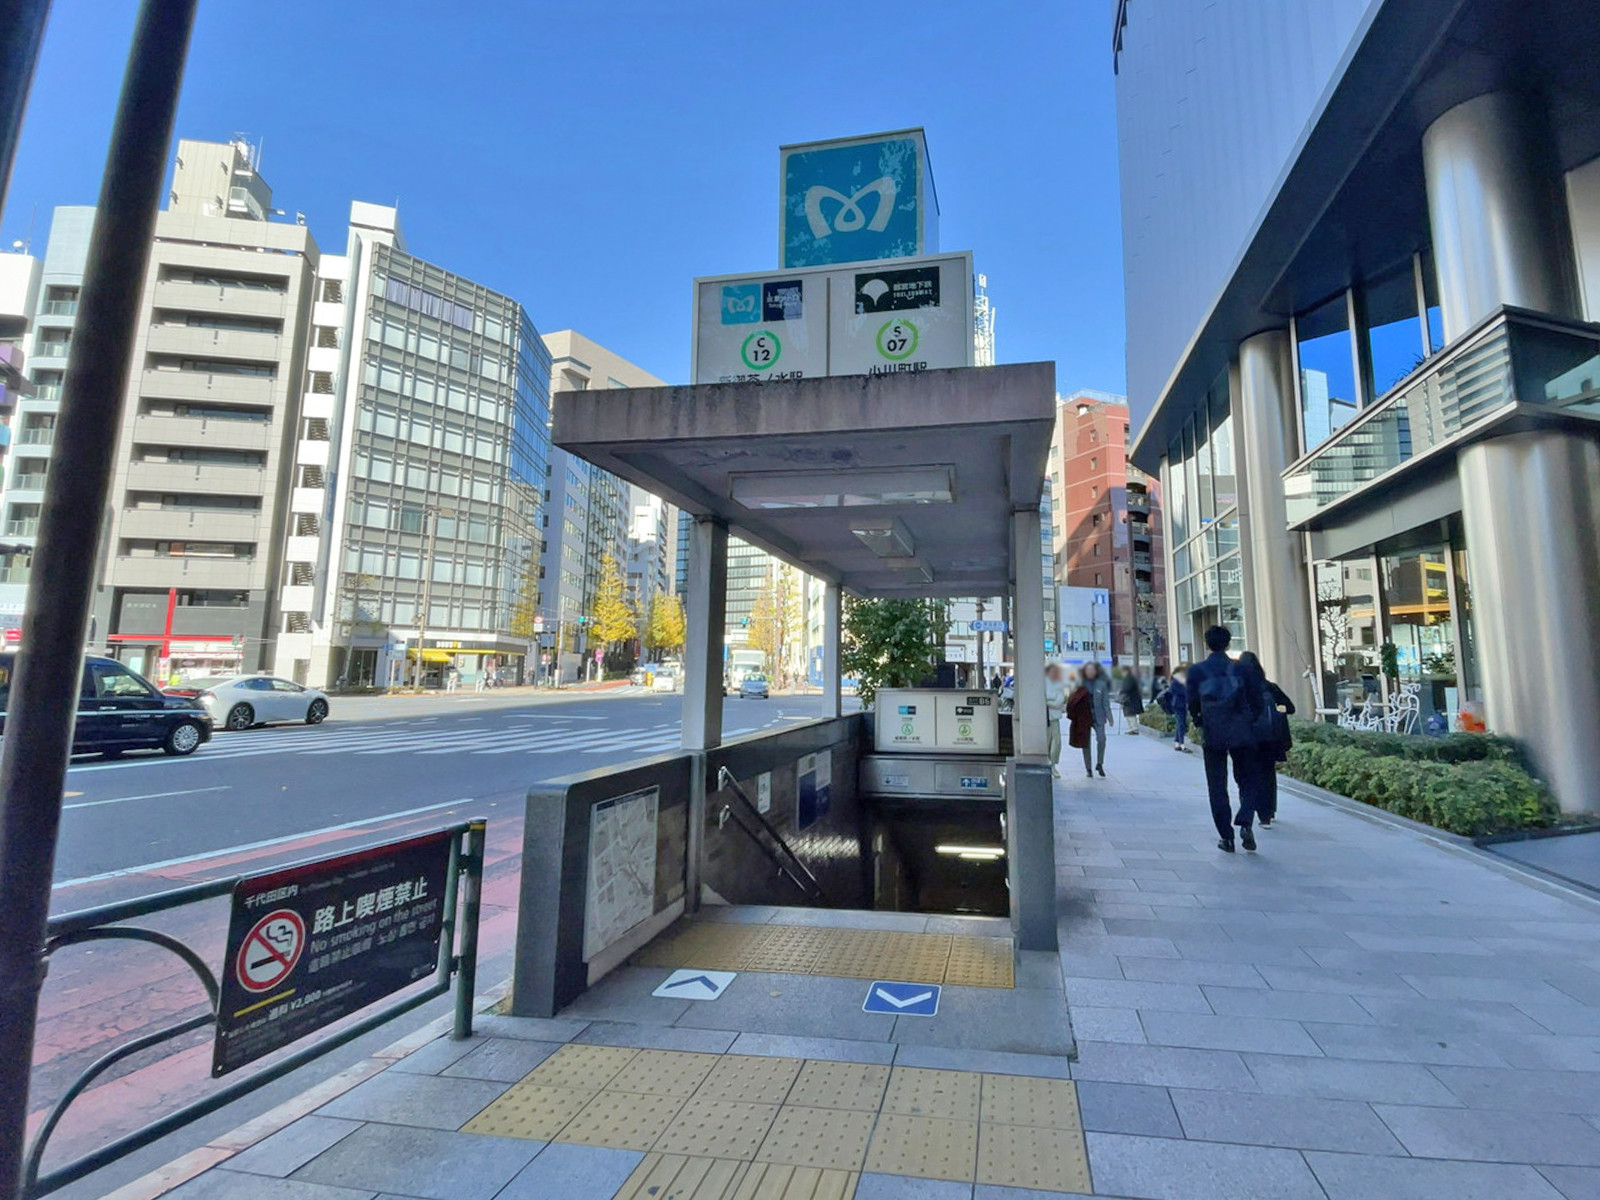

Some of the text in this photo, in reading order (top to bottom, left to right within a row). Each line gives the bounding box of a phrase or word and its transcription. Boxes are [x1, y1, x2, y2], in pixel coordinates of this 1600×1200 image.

[893, 326, 902, 337] S
[757, 337, 766, 348] C
[887, 339, 907, 352] 07
[753, 349, 770, 361] 12
[245, 885, 299, 908] 千代田区内
[312, 876, 428, 935] 路上喫煙禁止
[310, 940, 328, 954] No
[330, 922, 376, 947] smoking
[378, 916, 392, 929] on
